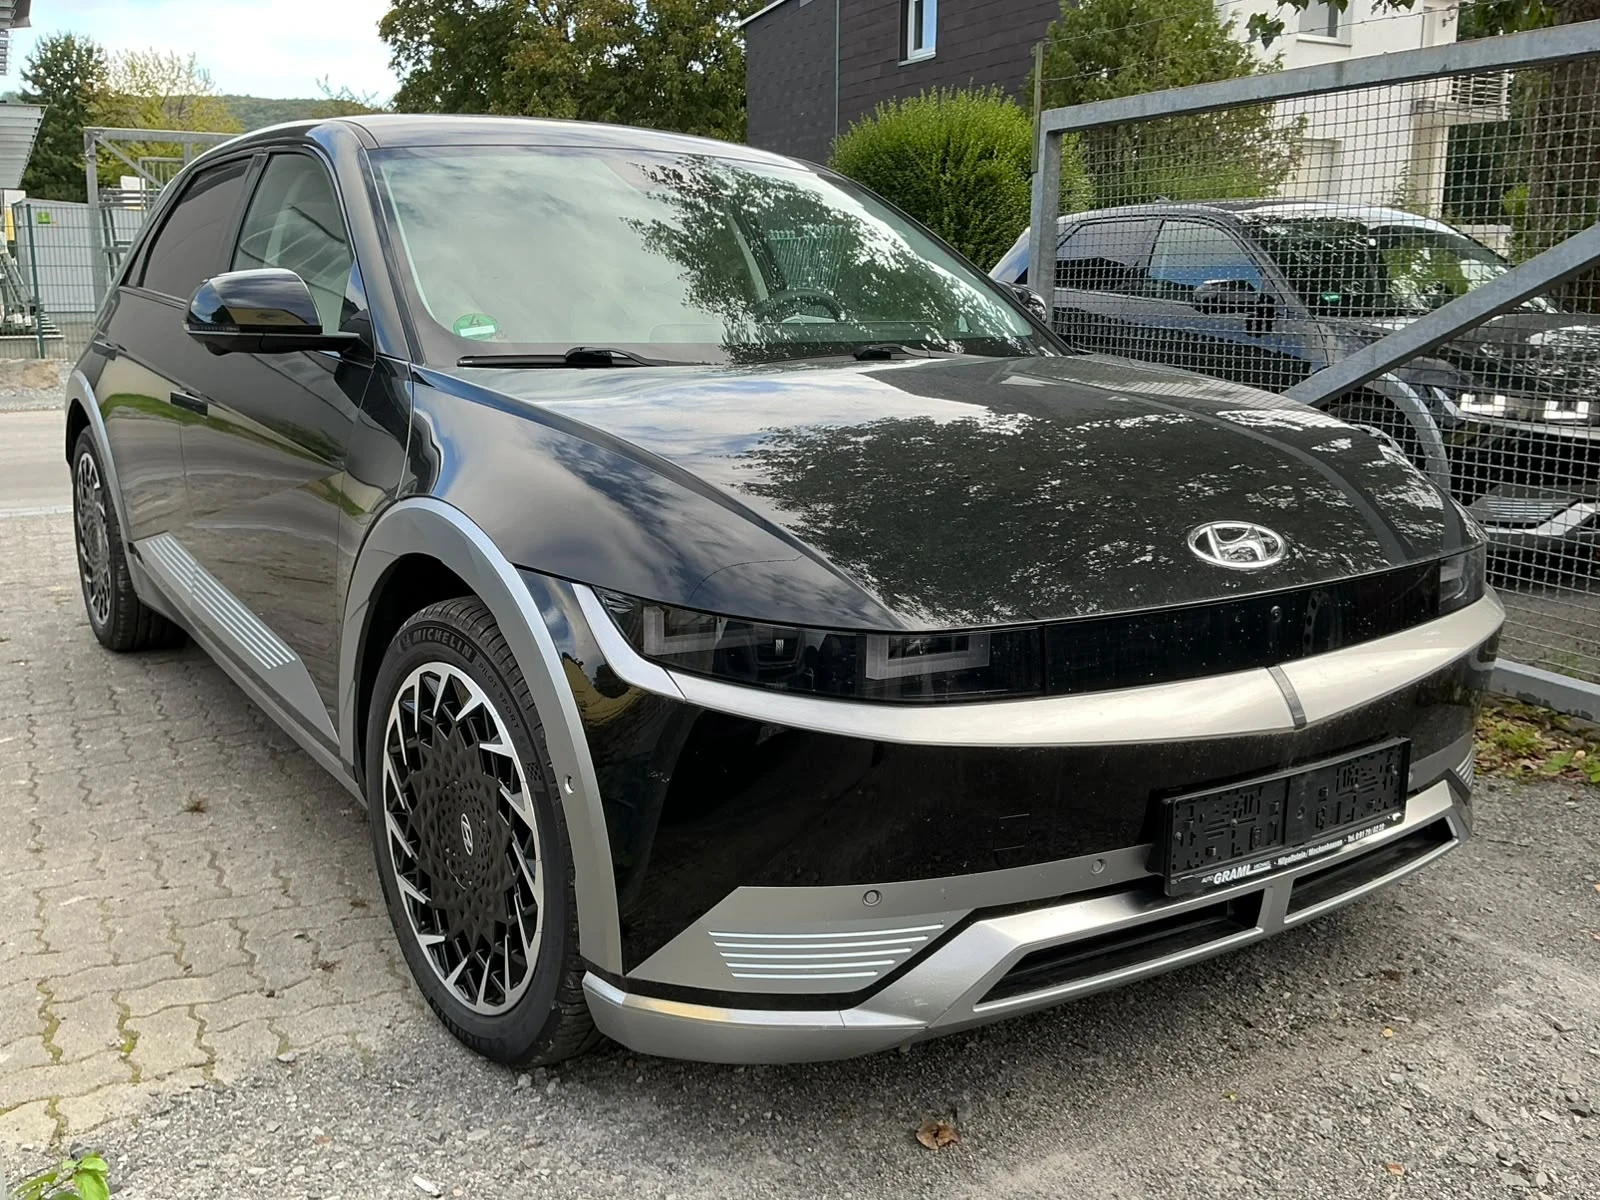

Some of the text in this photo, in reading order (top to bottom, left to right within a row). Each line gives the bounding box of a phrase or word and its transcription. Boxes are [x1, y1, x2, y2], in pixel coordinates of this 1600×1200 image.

[413, 628, 473, 660] MICHELIN
[478, 662, 498, 688] PILOT
[499, 692, 520, 729] SPORT
[1213, 864, 1251, 885] GRAML
